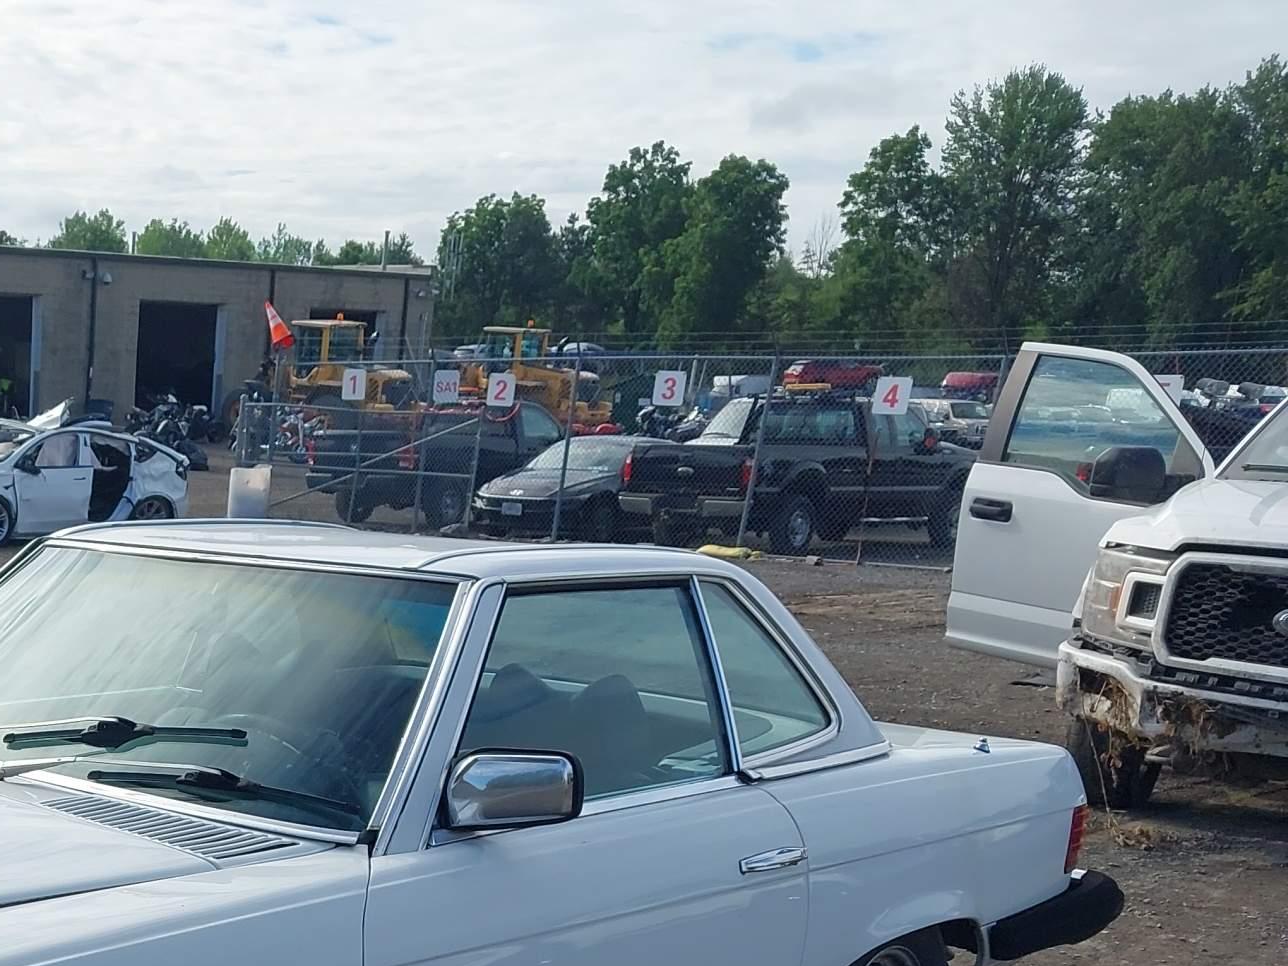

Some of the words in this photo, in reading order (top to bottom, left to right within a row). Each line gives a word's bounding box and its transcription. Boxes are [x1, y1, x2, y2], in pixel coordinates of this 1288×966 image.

[349, 375, 358, 395] 1
[493, 380, 509, 400] 2
[661, 377, 677, 400] 3
[882, 383, 900, 408] 4
